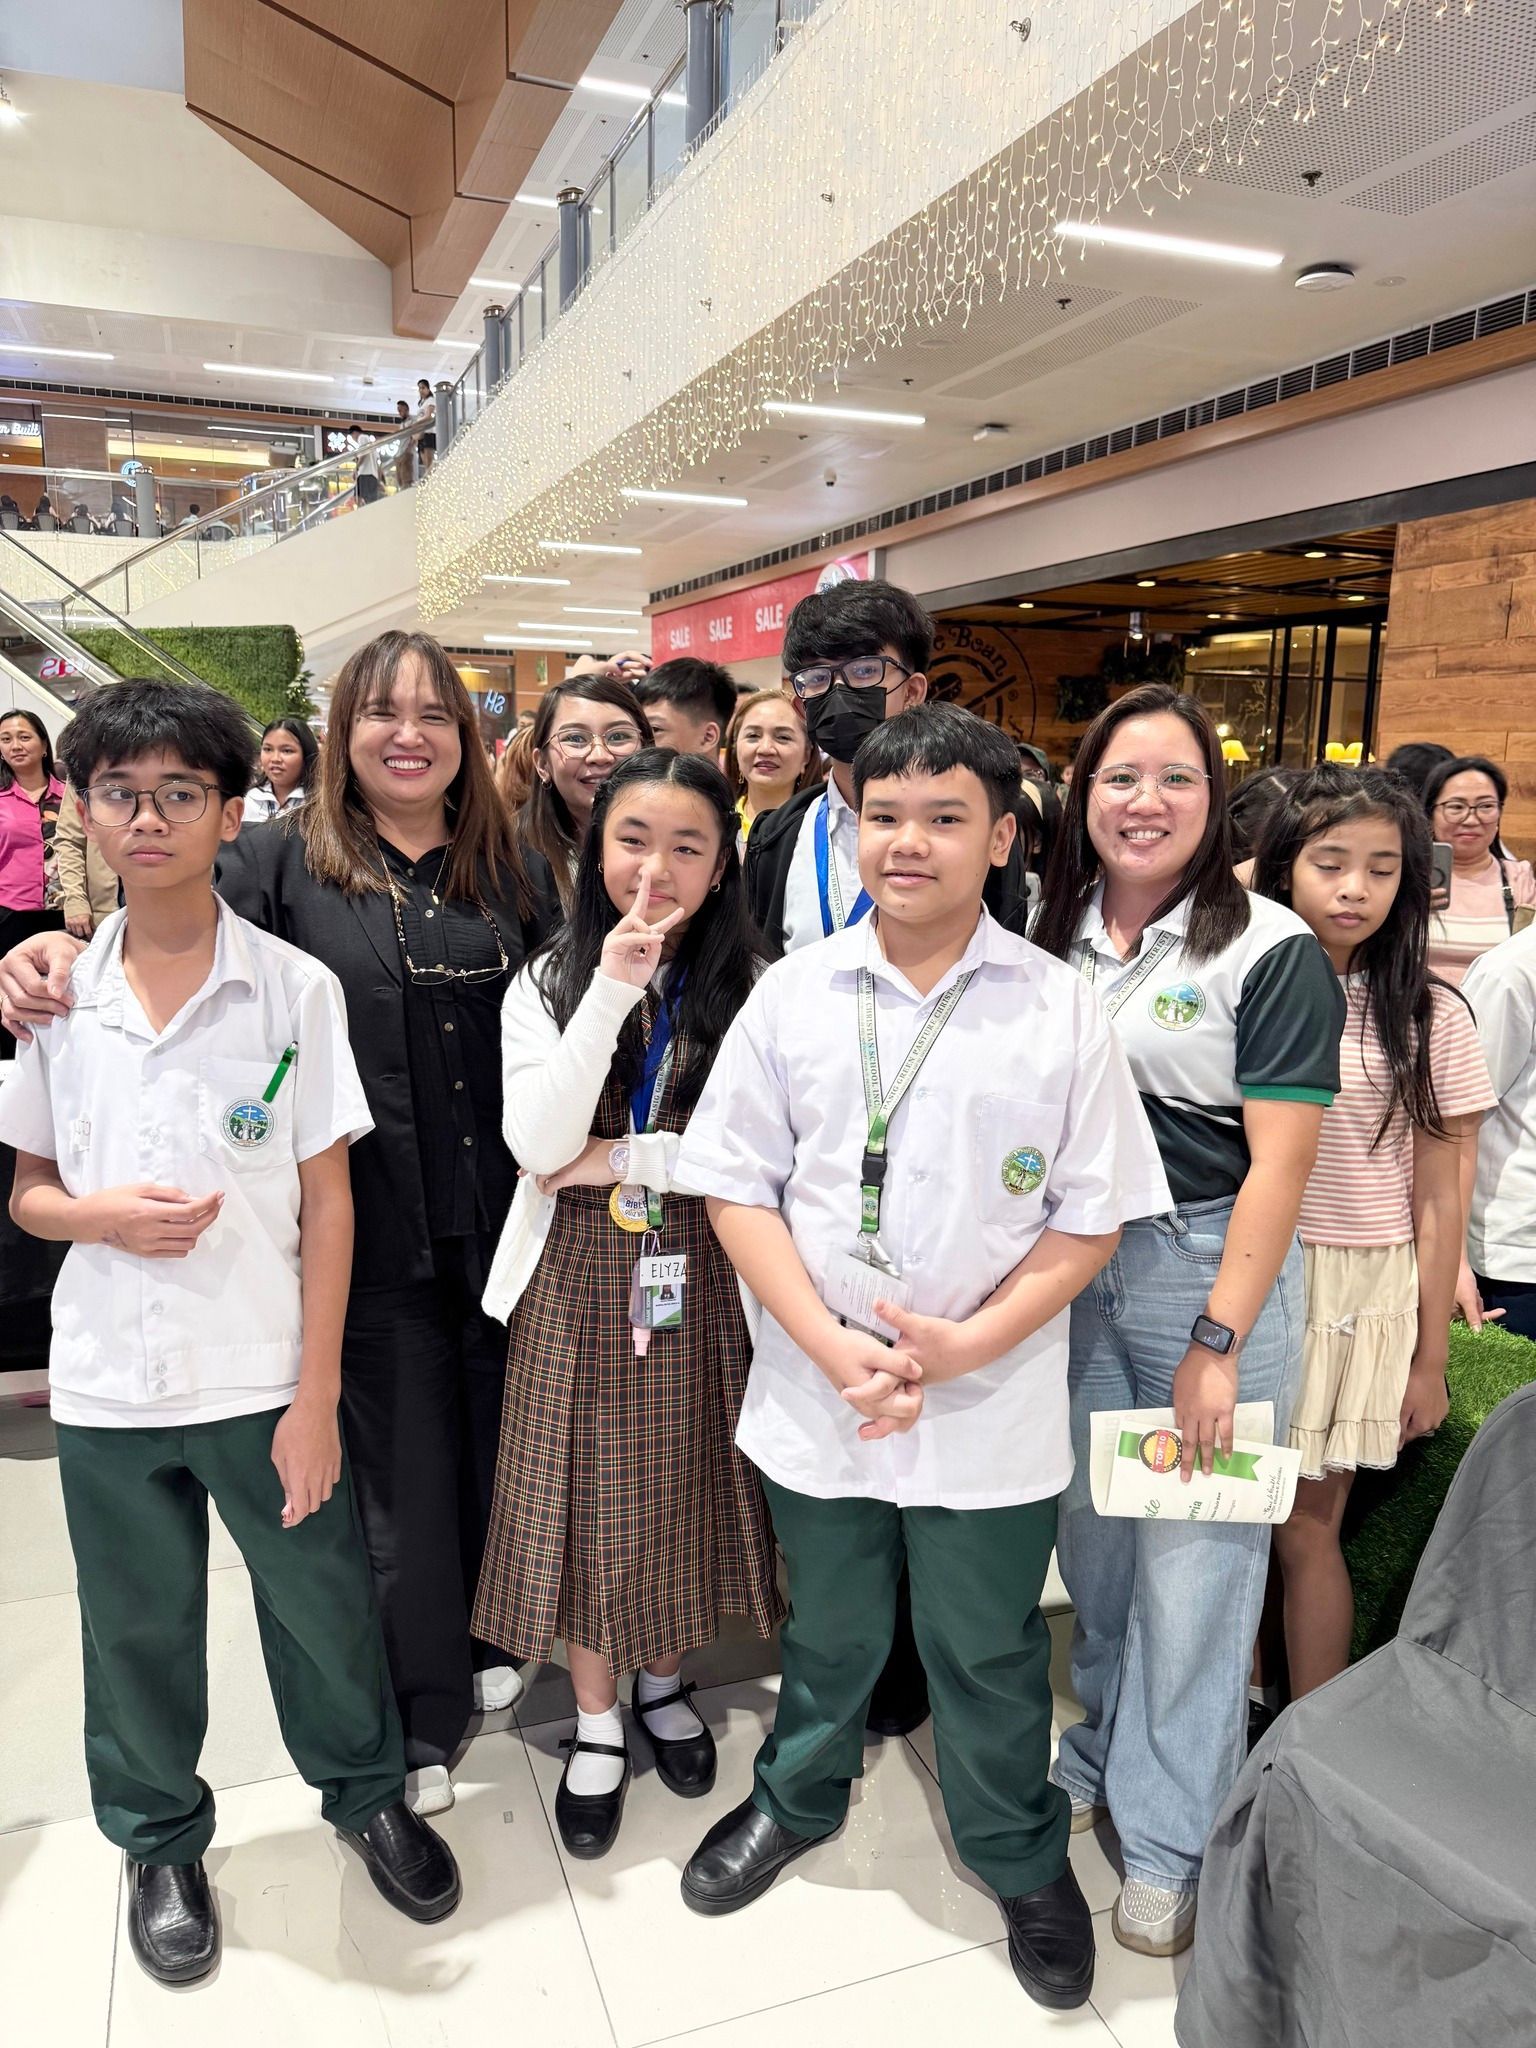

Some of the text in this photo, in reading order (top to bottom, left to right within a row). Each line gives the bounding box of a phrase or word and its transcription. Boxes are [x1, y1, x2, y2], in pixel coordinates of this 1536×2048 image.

[11, 422, 40, 436] Built
[670, 604, 784, 650] SALE SALE SALE
[948, 625, 1008, 677] Bean
[864, 971, 873, 1000] ASTURE
[1117, 966, 1146, 1000] PASTURE
[866, 1002, 876, 1049] CHRISTIAN
[869, 1050, 879, 1087] SCHOOL
[883, 1084, 899, 1110] PASIG
[900, 1056, 916, 1085] GREEN
[913, 1018, 937, 1055] PASTURE
[650, 1095, 660, 1118] PASIG
[625, 1200, 648, 1209] BIBLE
[1156, 1435, 1167, 1465] TOP 10
